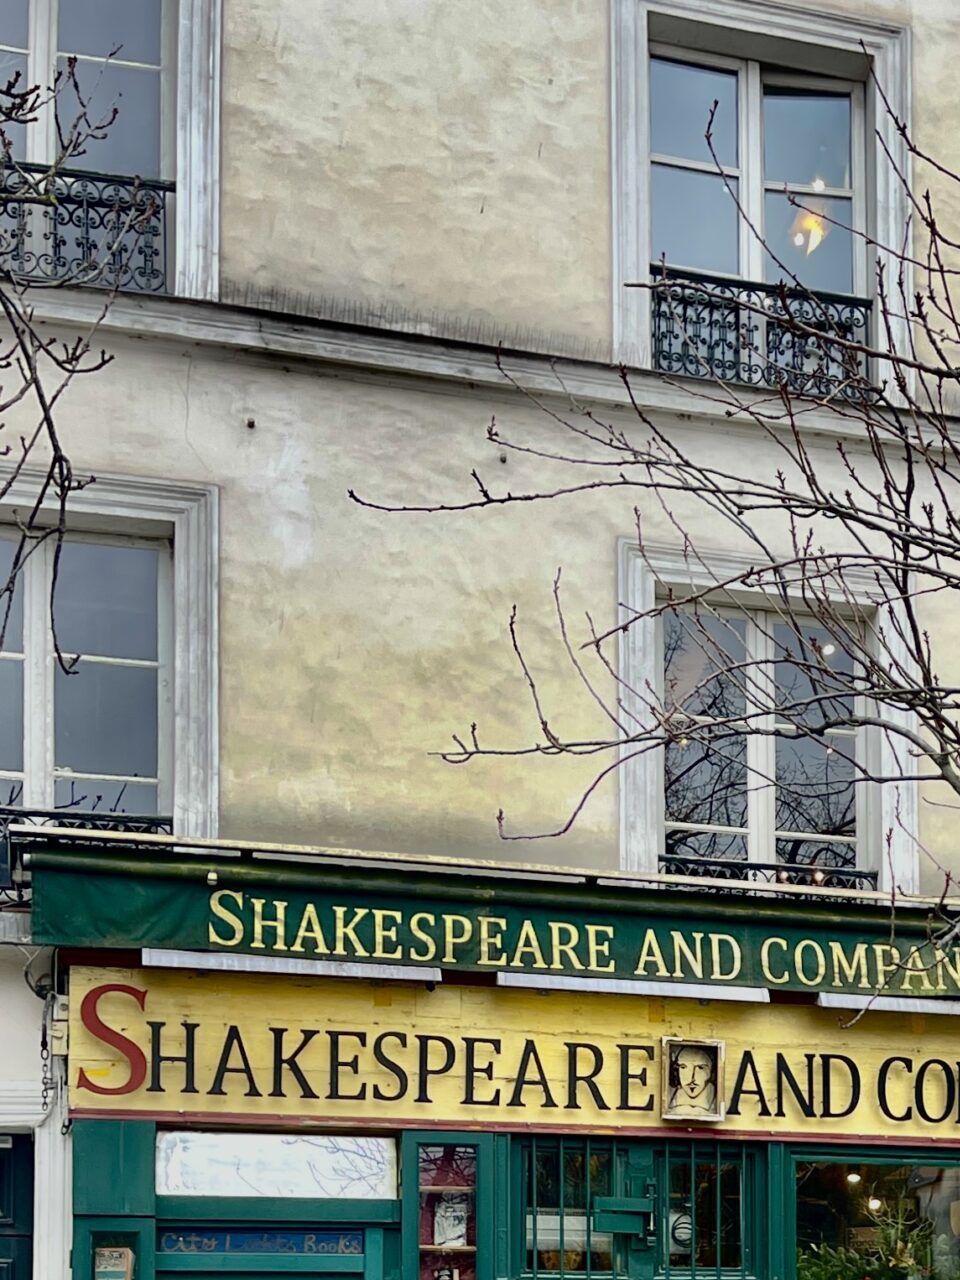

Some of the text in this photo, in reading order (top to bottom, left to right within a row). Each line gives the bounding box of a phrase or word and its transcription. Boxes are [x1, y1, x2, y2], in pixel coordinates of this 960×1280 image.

[208, 889, 616, 973] SHAKESPEARE
[634, 928, 743, 981] AND
[76, 984, 656, 1112] SHAKESPEARE
[726, 1049, 862, 1119] AND
[303, 1233, 362, 1253] Books
